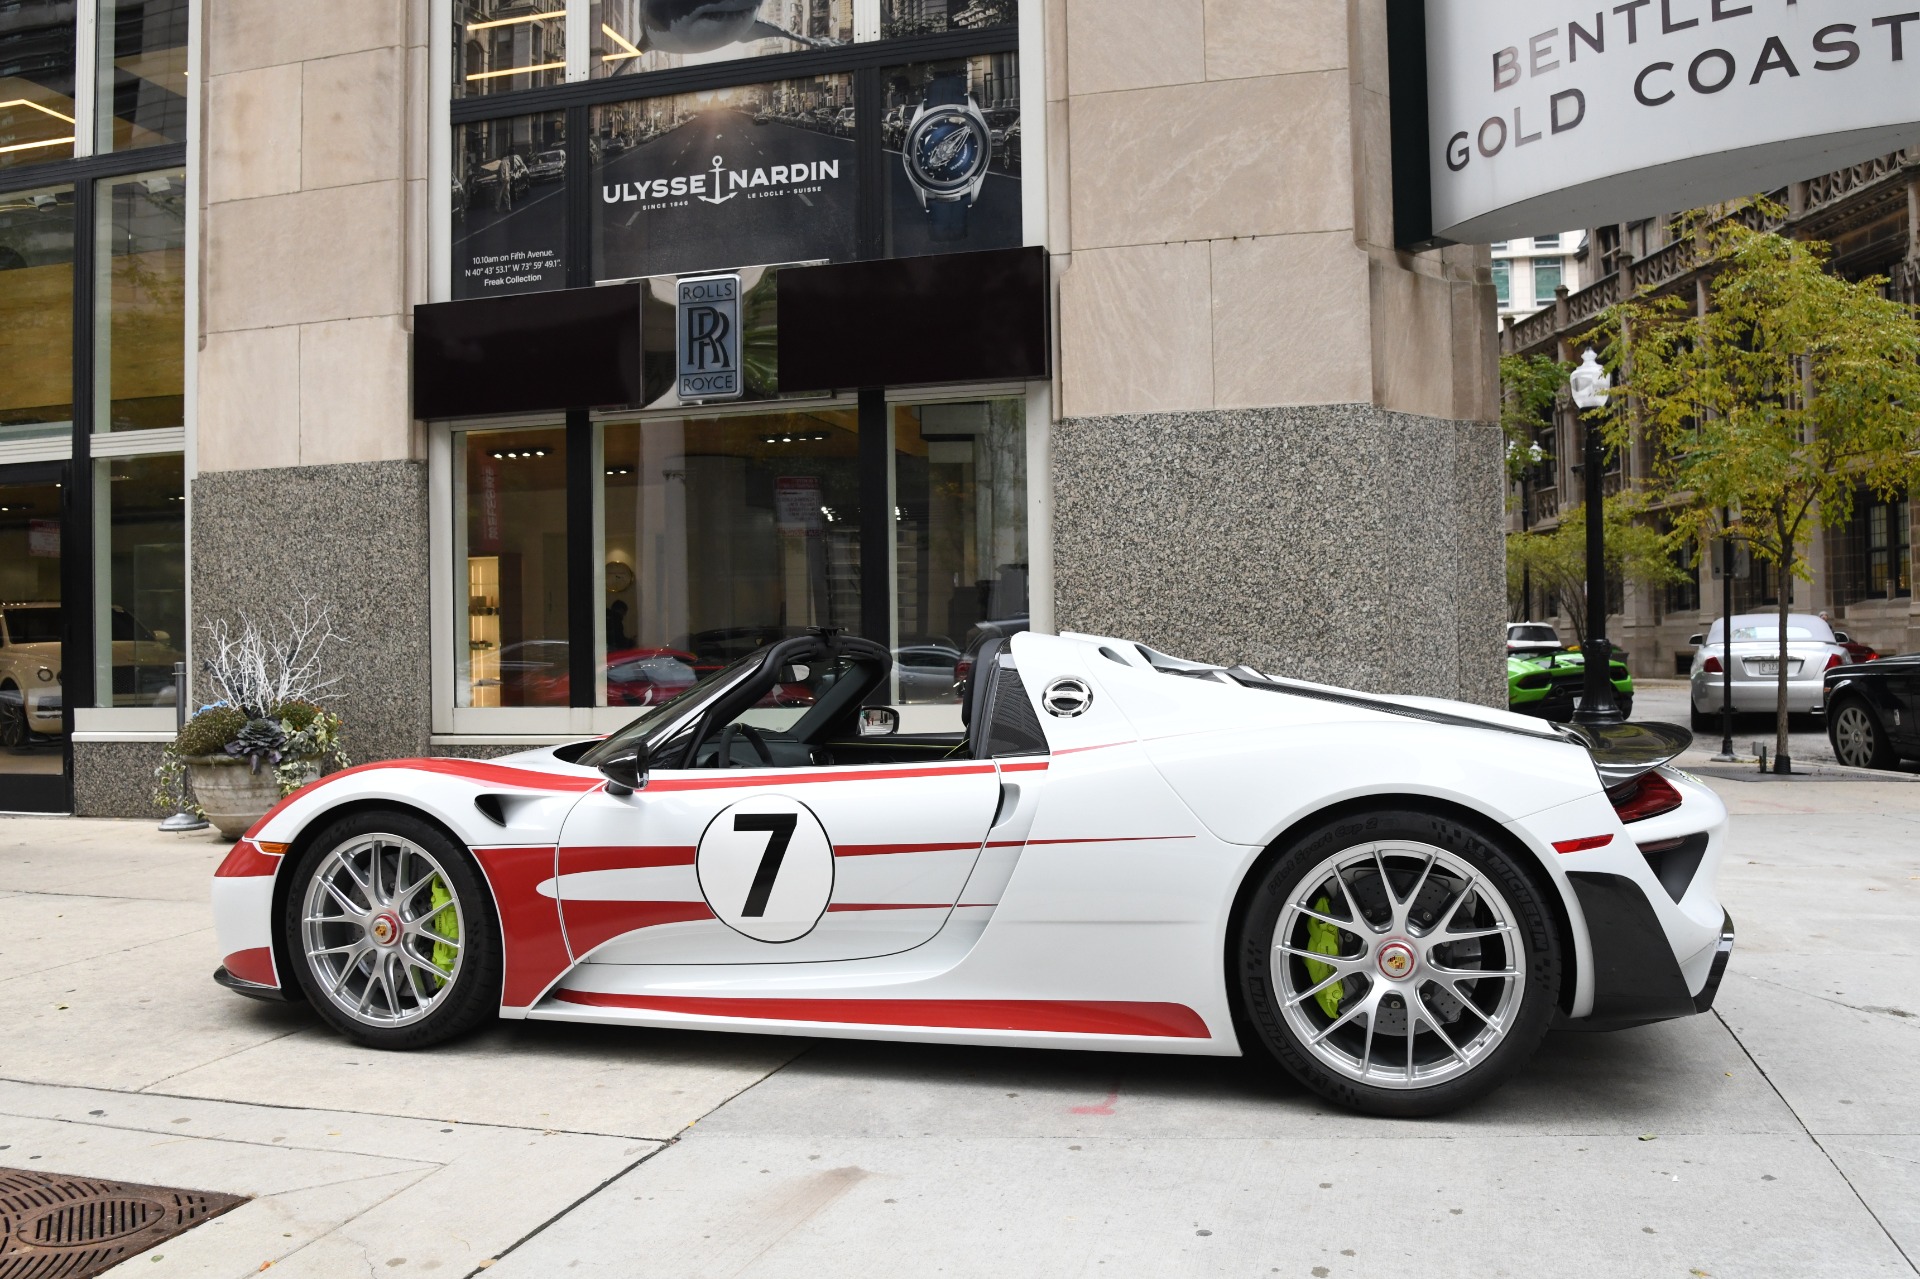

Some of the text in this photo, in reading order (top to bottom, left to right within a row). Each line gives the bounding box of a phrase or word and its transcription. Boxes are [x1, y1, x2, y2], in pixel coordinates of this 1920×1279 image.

[1492, 0, 1797, 93] BENTLE
[1446, 12, 1919, 172] GOLD COAST
[602, 159, 839, 204] ULYSSE NARDIN
[759, 189, 784, 199] LOCLE
[793, 185, 822, 195] SUISSE
[642, 200, 689, 211] SINCE 1846
[472, 249, 555, 265] 10.10am on Fifth Avenue.
[465, 269, 471, 277] N
[472, 268, 484, 276] 40°
[512, 264, 520, 272] W
[484, 274, 542, 287] Freak Collection
[682, 282, 732, 300] ROLLS
[683, 375, 733, 392] ROYCE
[1294, 832, 1333, 864] Sport
[1335, 823, 1363, 837] Cup
[733, 813, 798, 917] 7
[1487, 856, 1549, 951] MICHELIN
